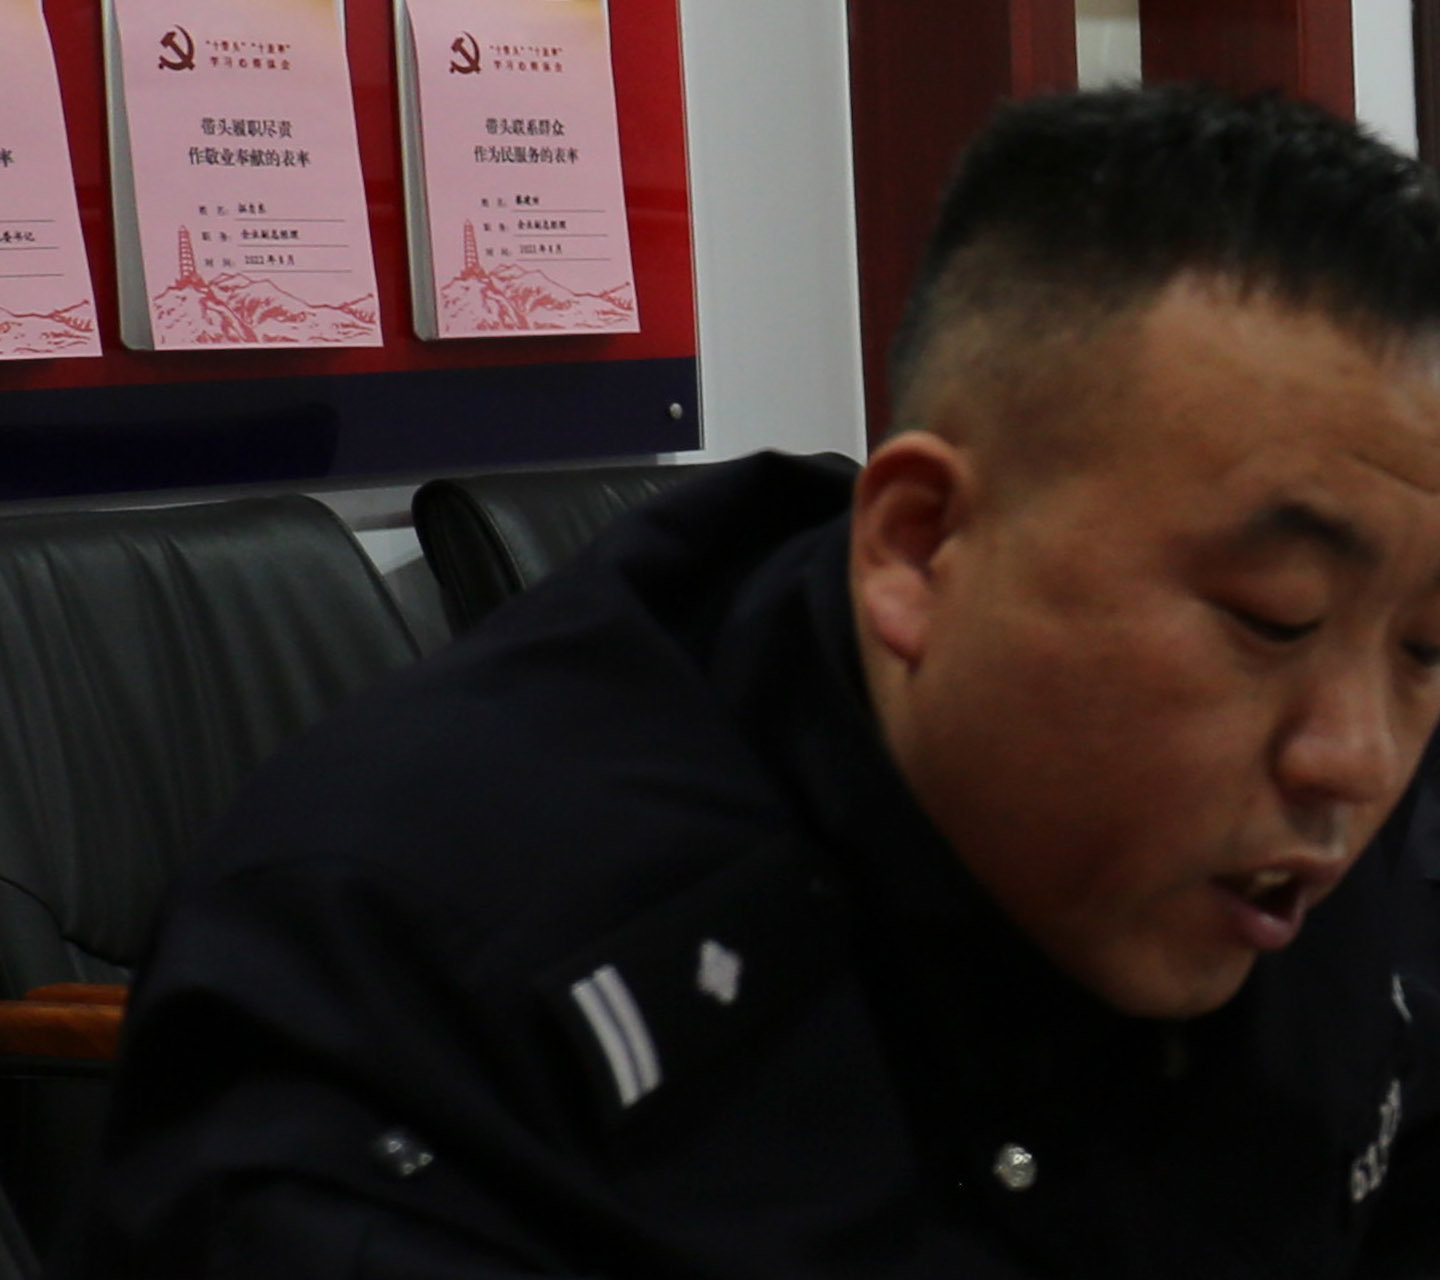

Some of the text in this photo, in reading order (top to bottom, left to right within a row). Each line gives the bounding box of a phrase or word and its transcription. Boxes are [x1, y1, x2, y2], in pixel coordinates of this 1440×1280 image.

[201, 117, 293, 138] 带头履职尽责
[486, 118, 565, 136] 带头联系群众
[188, 146, 310, 168] 作敬业奉献的表率
[474, 145, 579, 164] 作为民服务的表率
